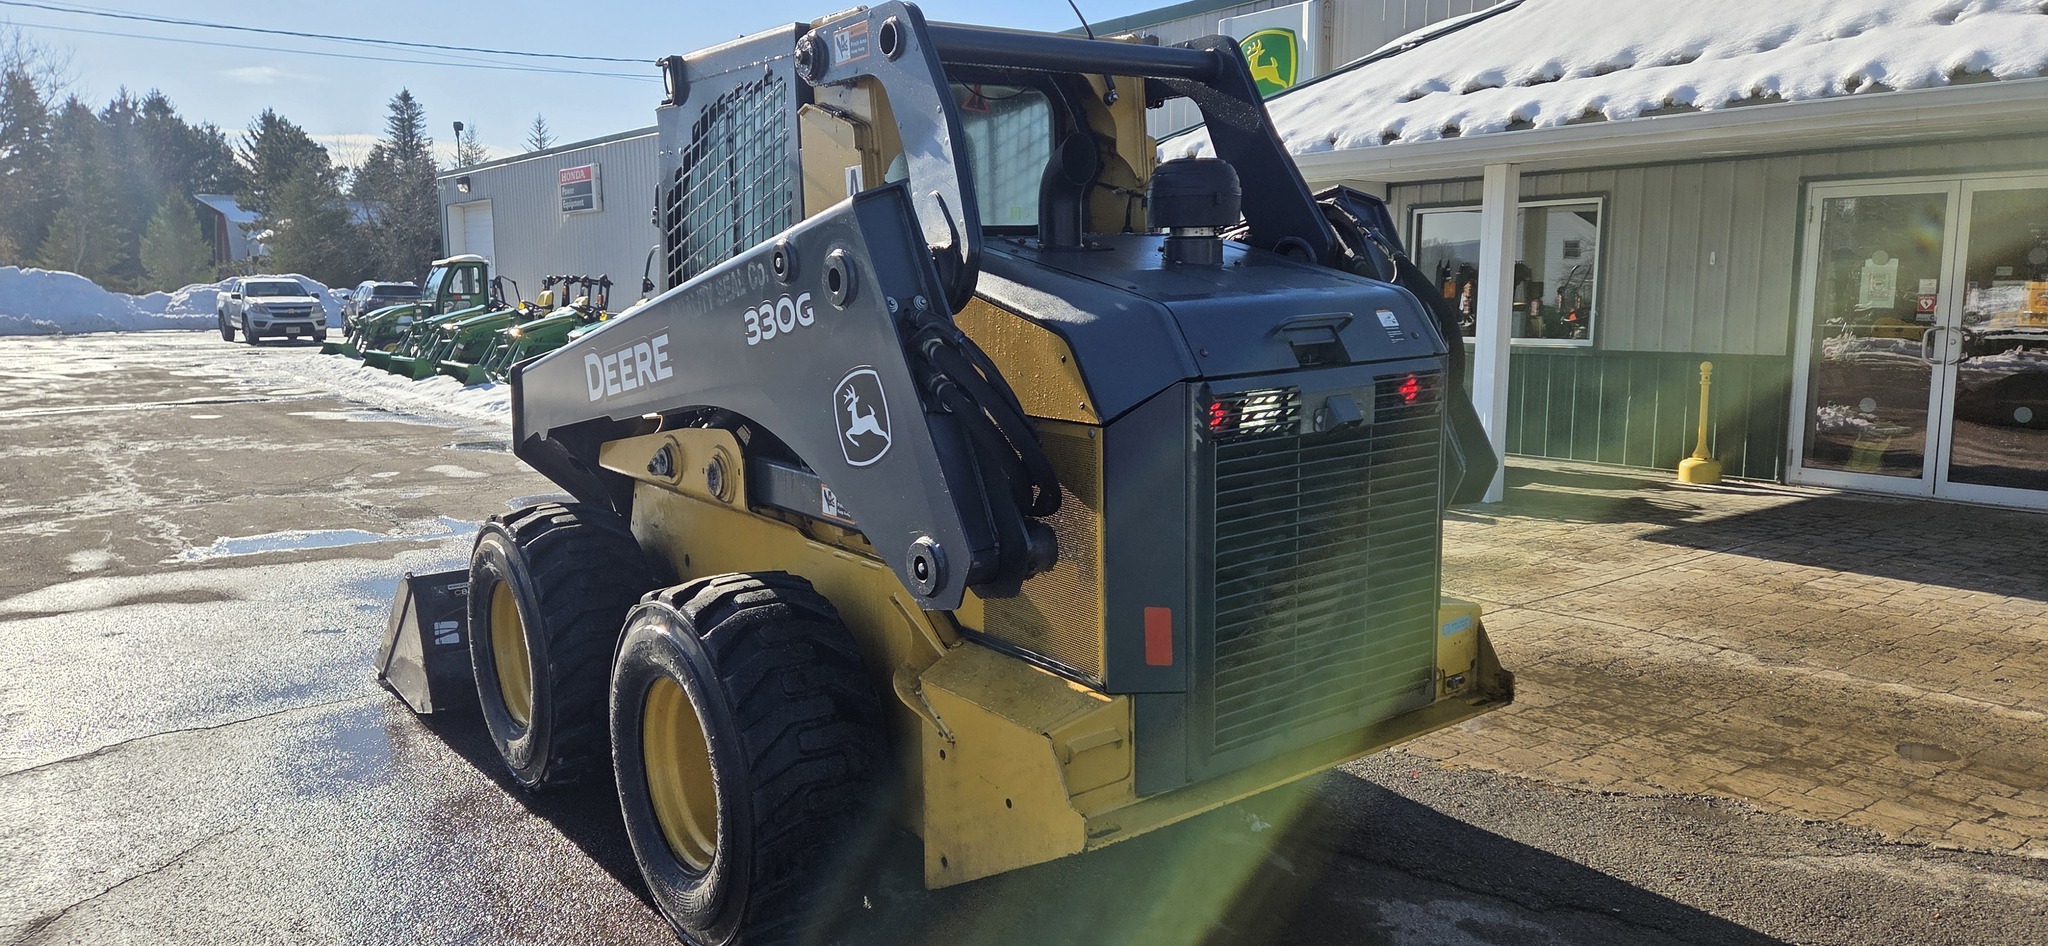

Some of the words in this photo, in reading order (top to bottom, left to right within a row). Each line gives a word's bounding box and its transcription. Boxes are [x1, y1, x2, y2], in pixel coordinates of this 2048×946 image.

[561, 170, 585, 182] HONDA
[563, 199, 584, 210] Equipment
[744, 292, 815, 346] 330G
[584, 333, 674, 402] DEERE
